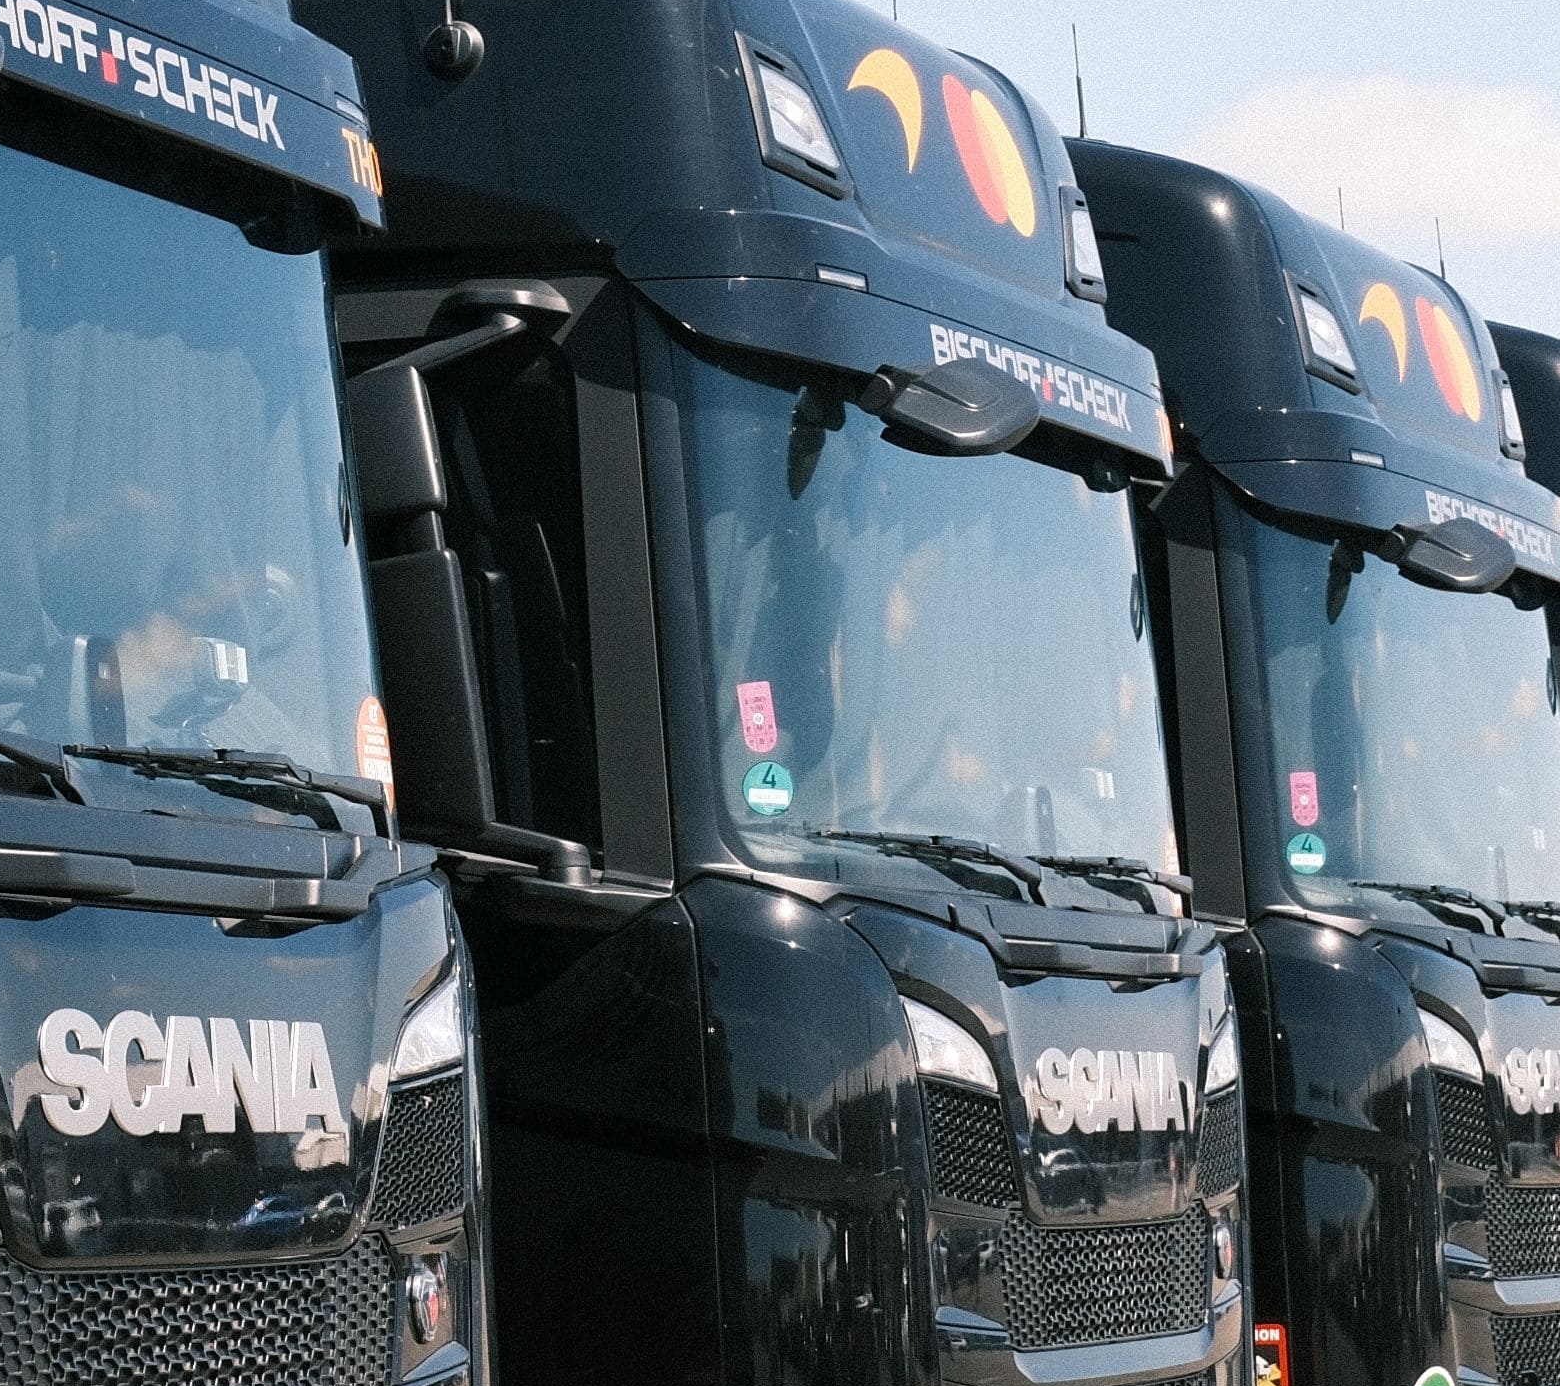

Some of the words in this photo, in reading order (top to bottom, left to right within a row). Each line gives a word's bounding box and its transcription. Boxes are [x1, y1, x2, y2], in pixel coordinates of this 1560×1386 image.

[126, 36, 286, 151] SCHECK
[1053, 367, 1132, 433] SCHECK
[762, 763, 777, 789] 4
[1301, 834, 1313, 853] 4
[37, 1007, 347, 1137] SCANIA
[1035, 1046, 1186, 1136] SCANIA
